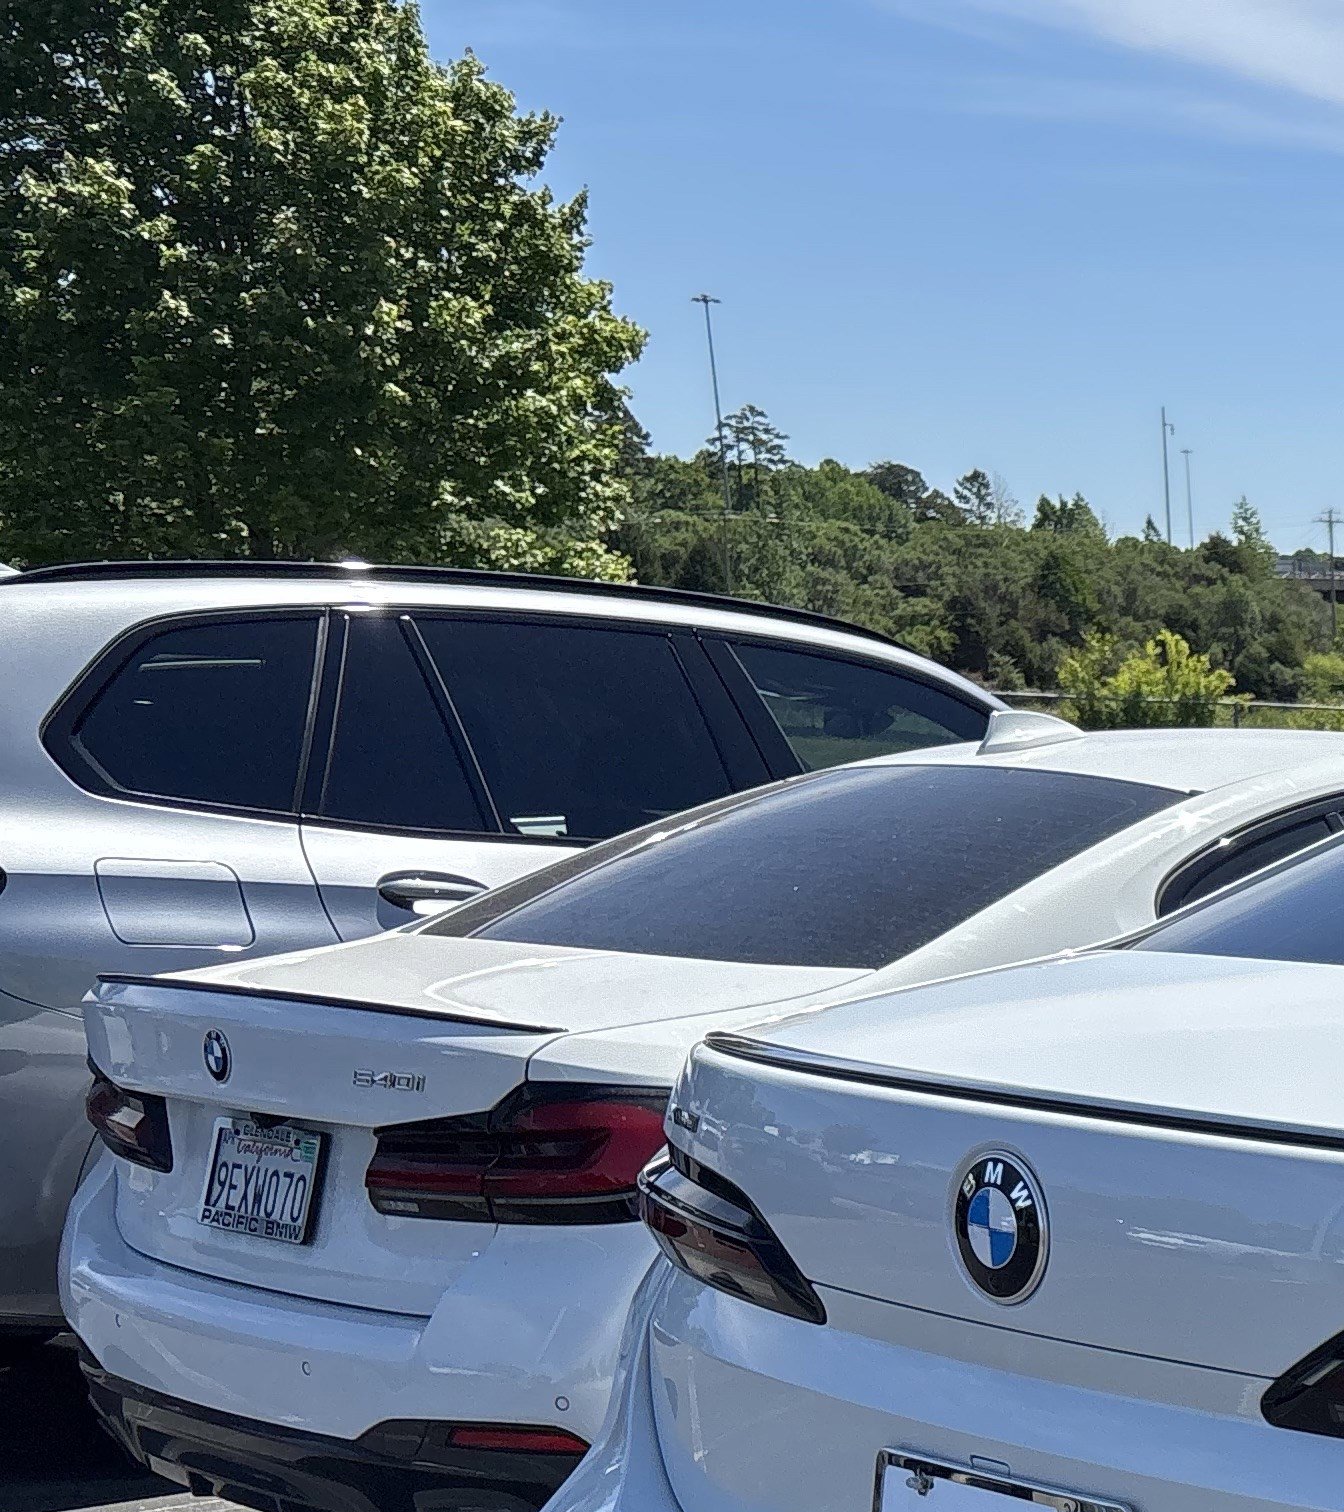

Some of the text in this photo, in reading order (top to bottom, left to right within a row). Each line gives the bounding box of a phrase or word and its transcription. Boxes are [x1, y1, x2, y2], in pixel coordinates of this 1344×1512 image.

[353, 1068, 426, 1093] 540i
[243, 1124, 293, 1143] GLENDALE
[236, 1139, 301, 1164] California
[212, 1160, 307, 1224] 9EXW070
[962, 1160, 1033, 1211] BMW
[200, 1207, 302, 1241] PACIFIC BMW
